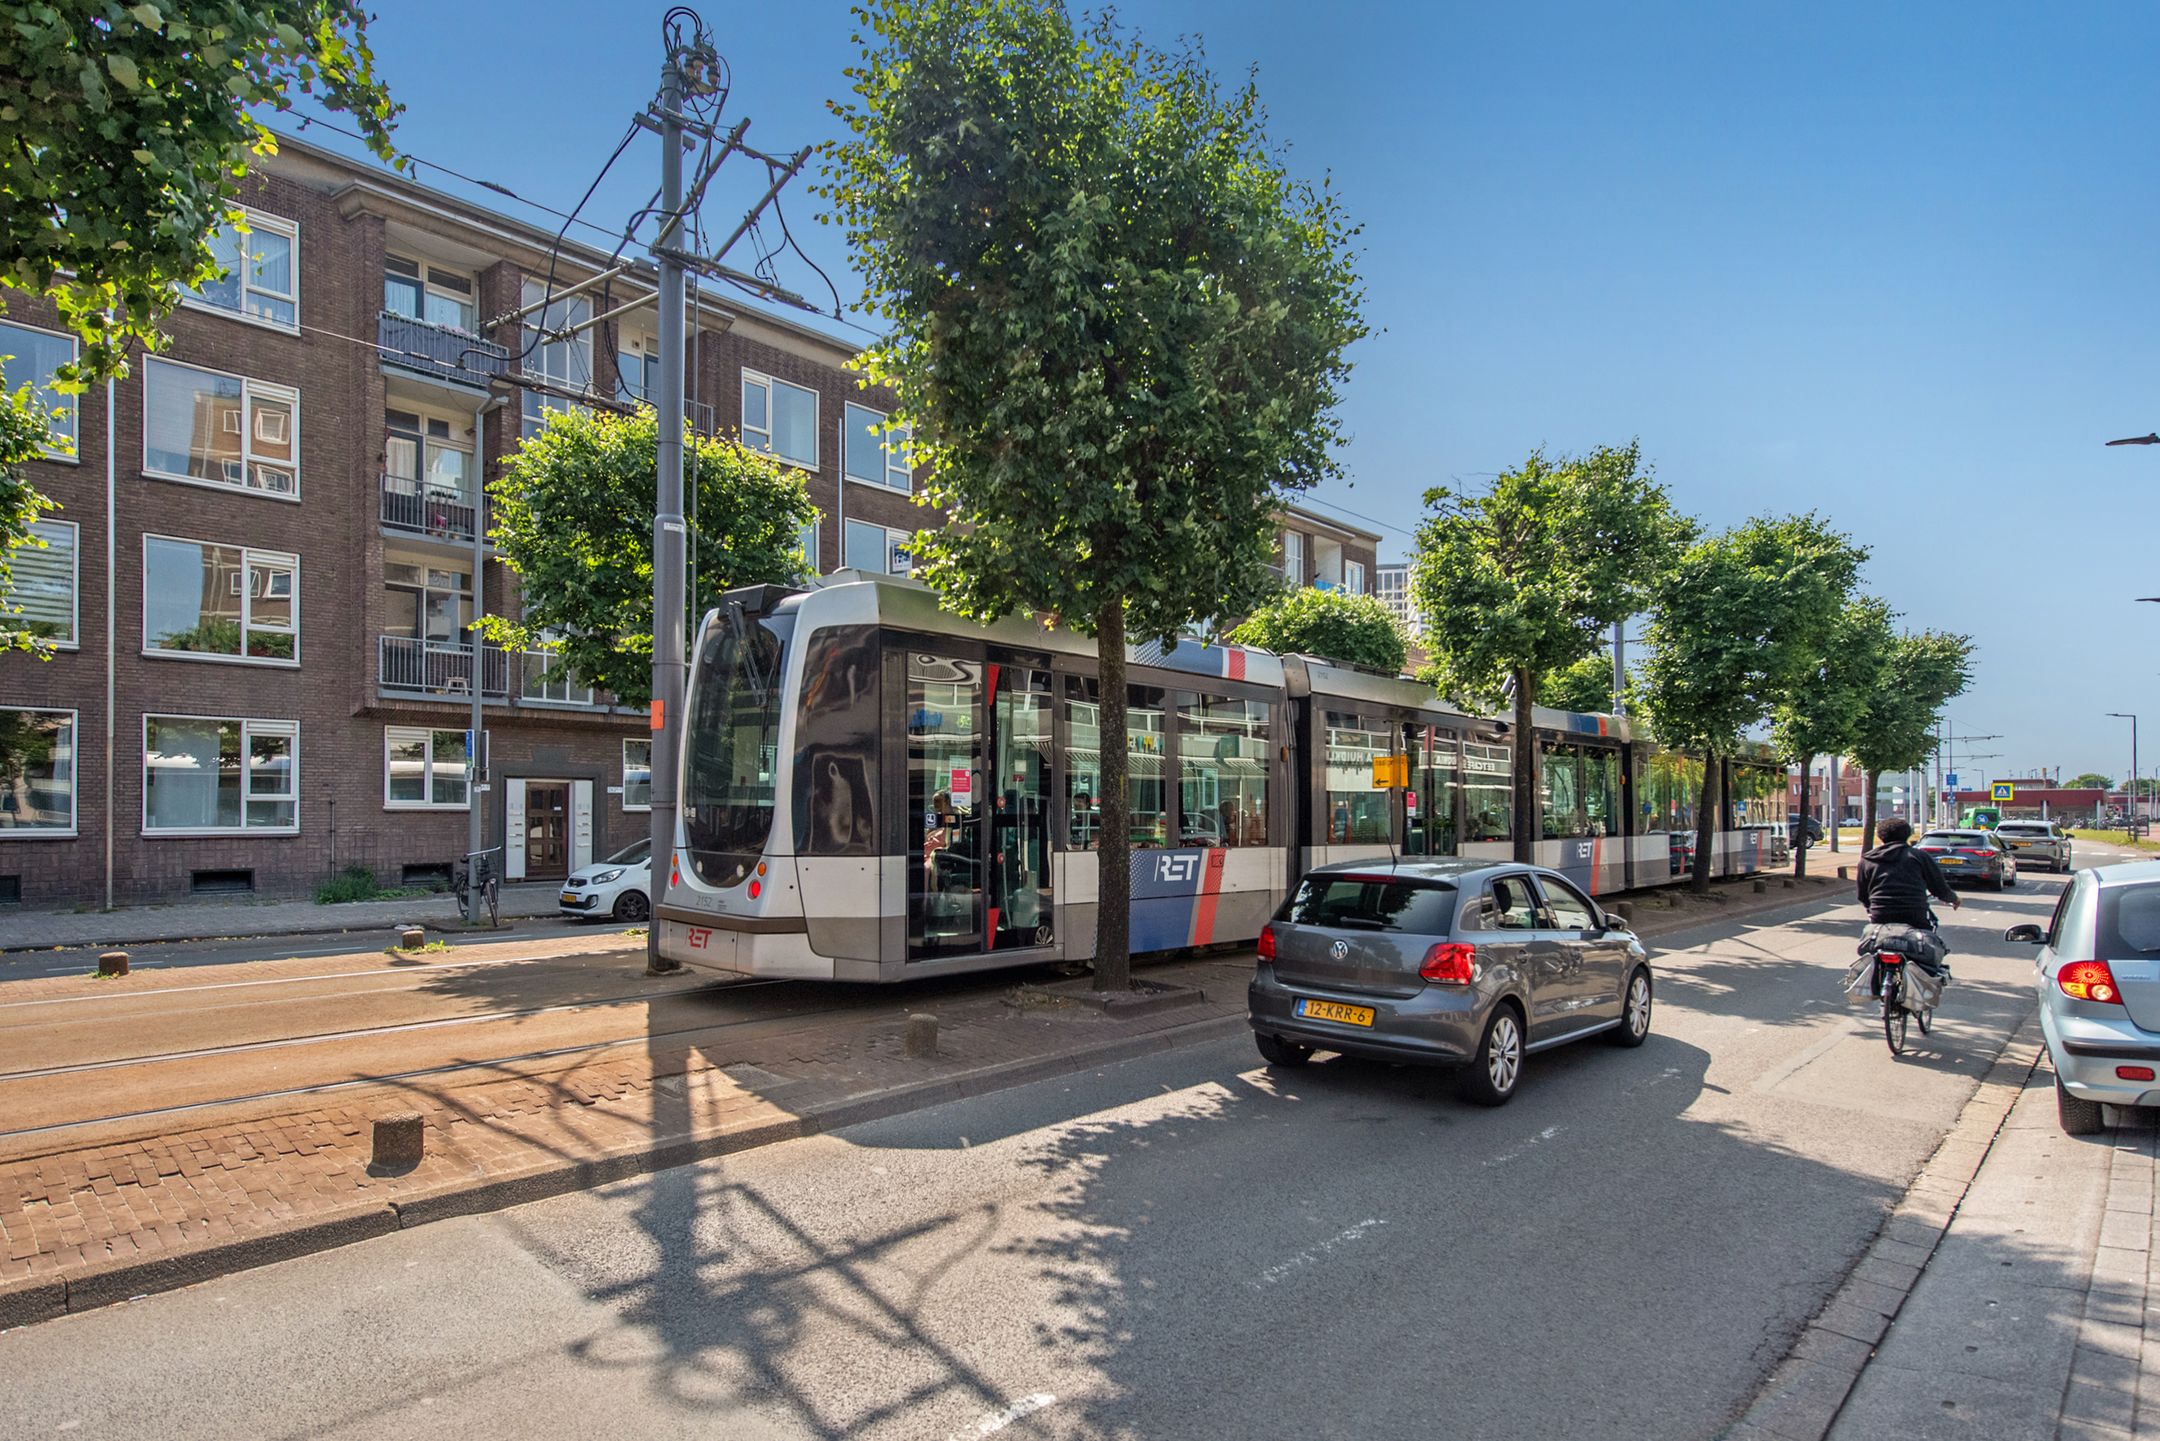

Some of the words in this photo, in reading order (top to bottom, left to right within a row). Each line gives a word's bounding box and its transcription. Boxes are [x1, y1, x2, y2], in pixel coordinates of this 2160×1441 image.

[1576, 842, 1592, 858] RET
[1153, 854, 1199, 882] RET
[695, 895, 713, 908] 2152
[685, 927, 713, 949] RET
[1309, 1002, 1367, 1022] 12-KRR-6
